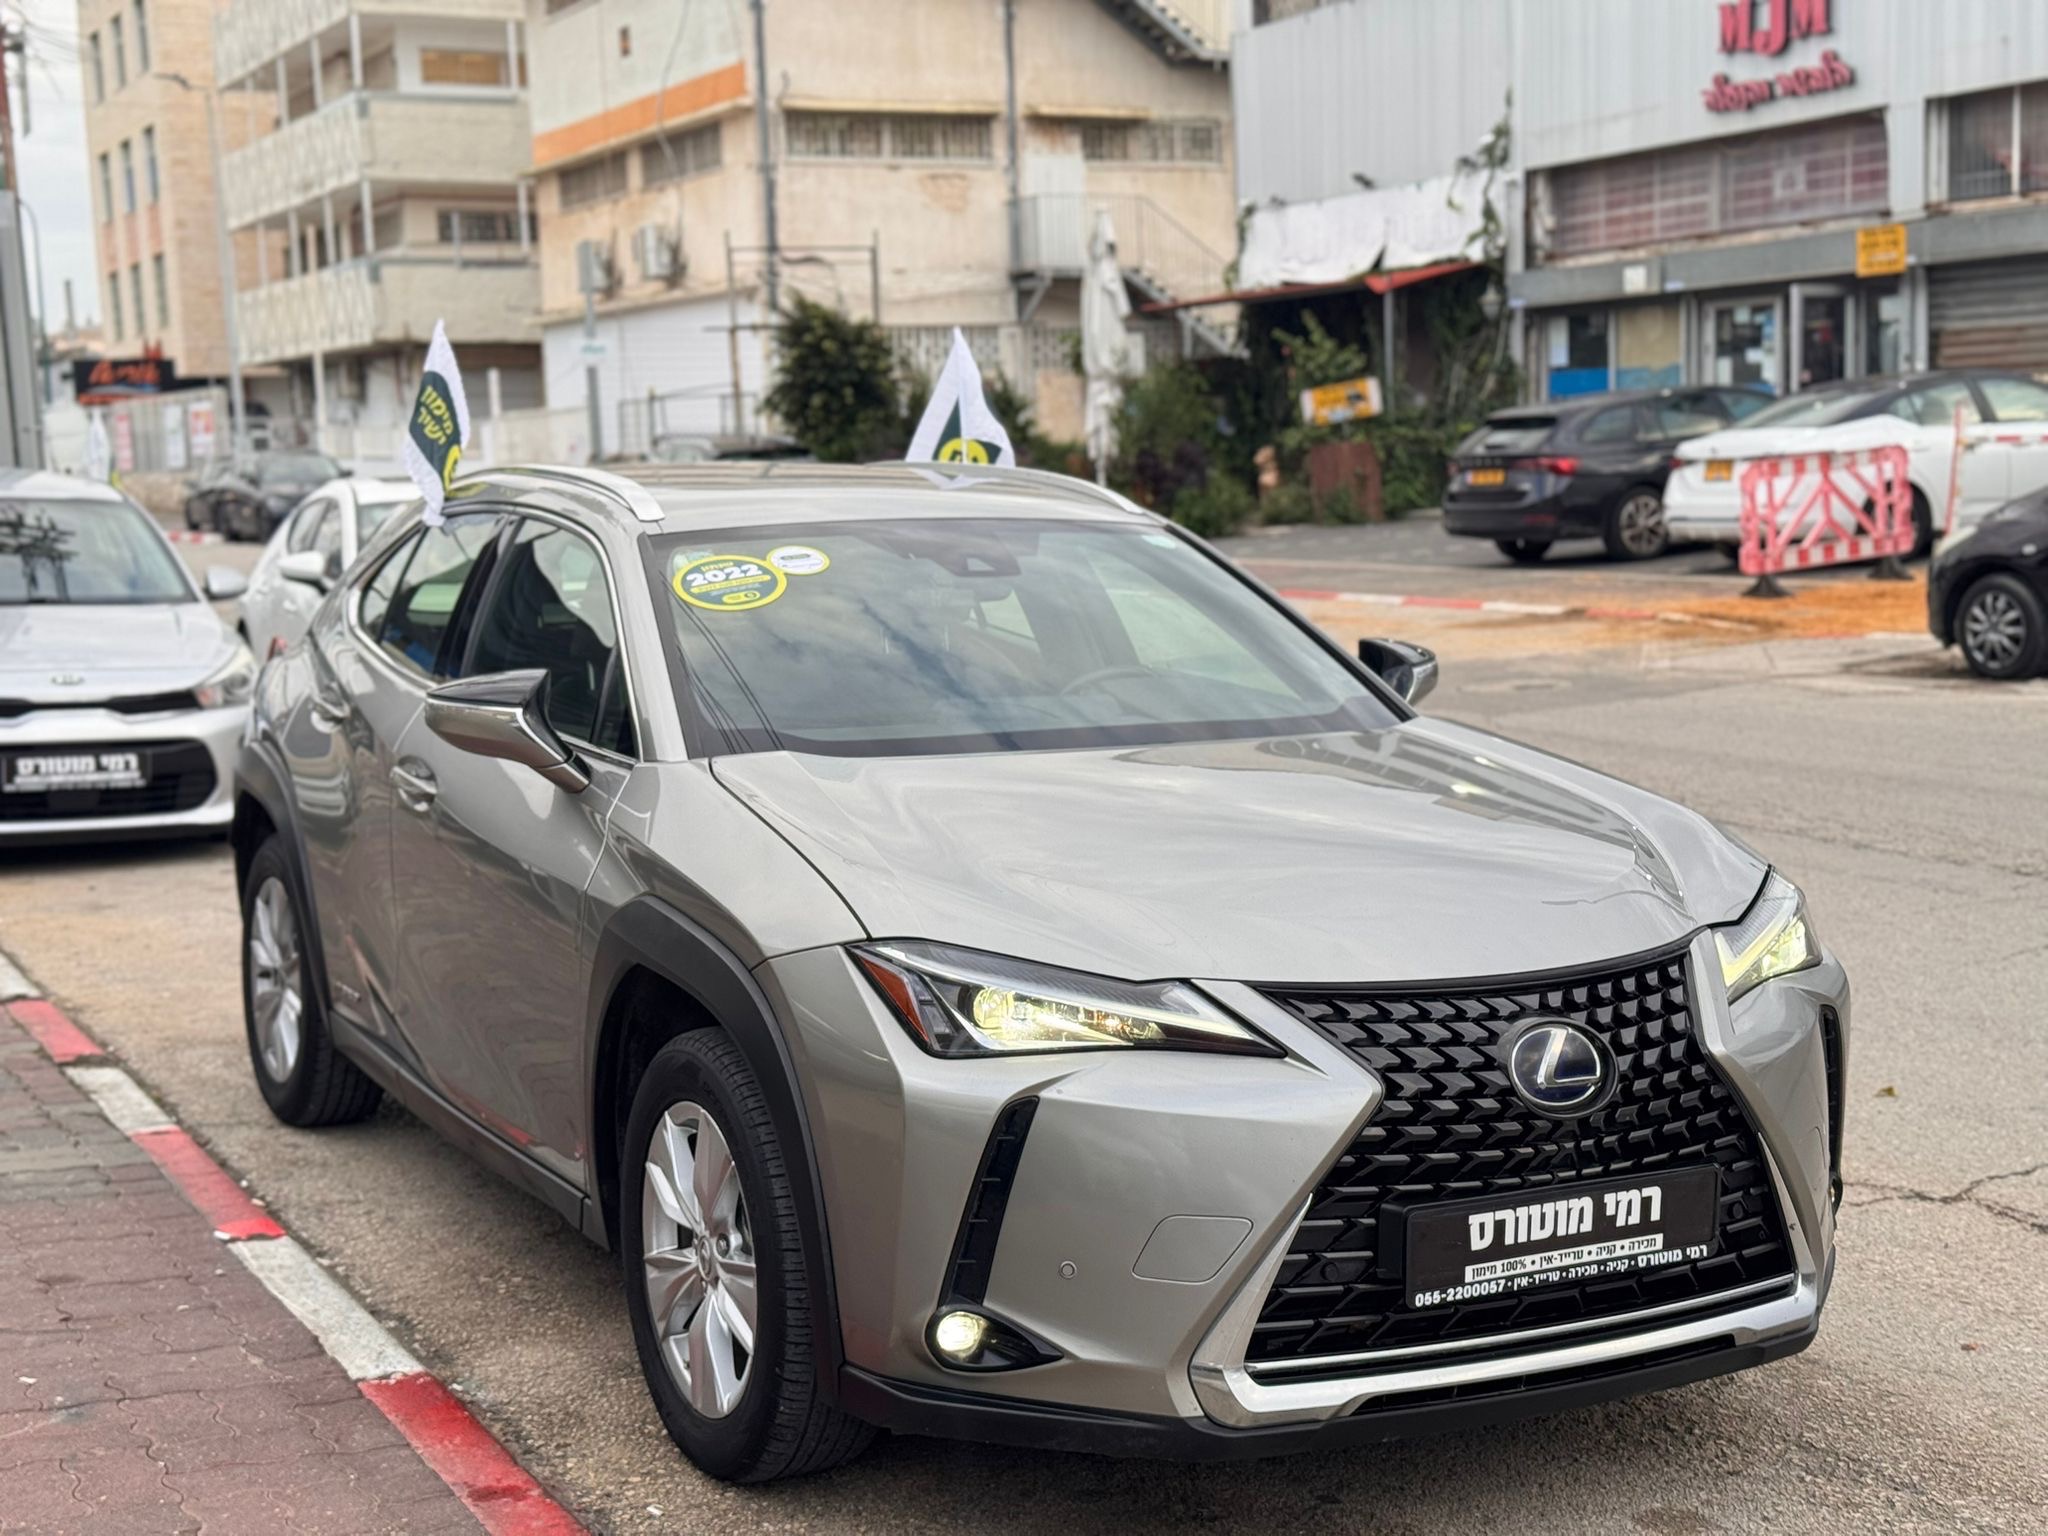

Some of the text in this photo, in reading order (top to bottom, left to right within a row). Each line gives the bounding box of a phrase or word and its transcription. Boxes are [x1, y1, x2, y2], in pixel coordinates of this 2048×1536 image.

[1718, 0, 1831, 57] MJM
[417, 405, 447, 446] ישיר
[420, 385, 454, 436] מימון
[686, 564, 763, 587] 2022
[1468, 1185, 1662, 1252] רמי מוטורס
[1415, 1244, 1708, 1308] רמי מוטורס קניה מכירה טרייד-אין 055-2200057
[1471, 1236, 1657, 1279] מכירה קניה טרייד-אין 100% מימון
